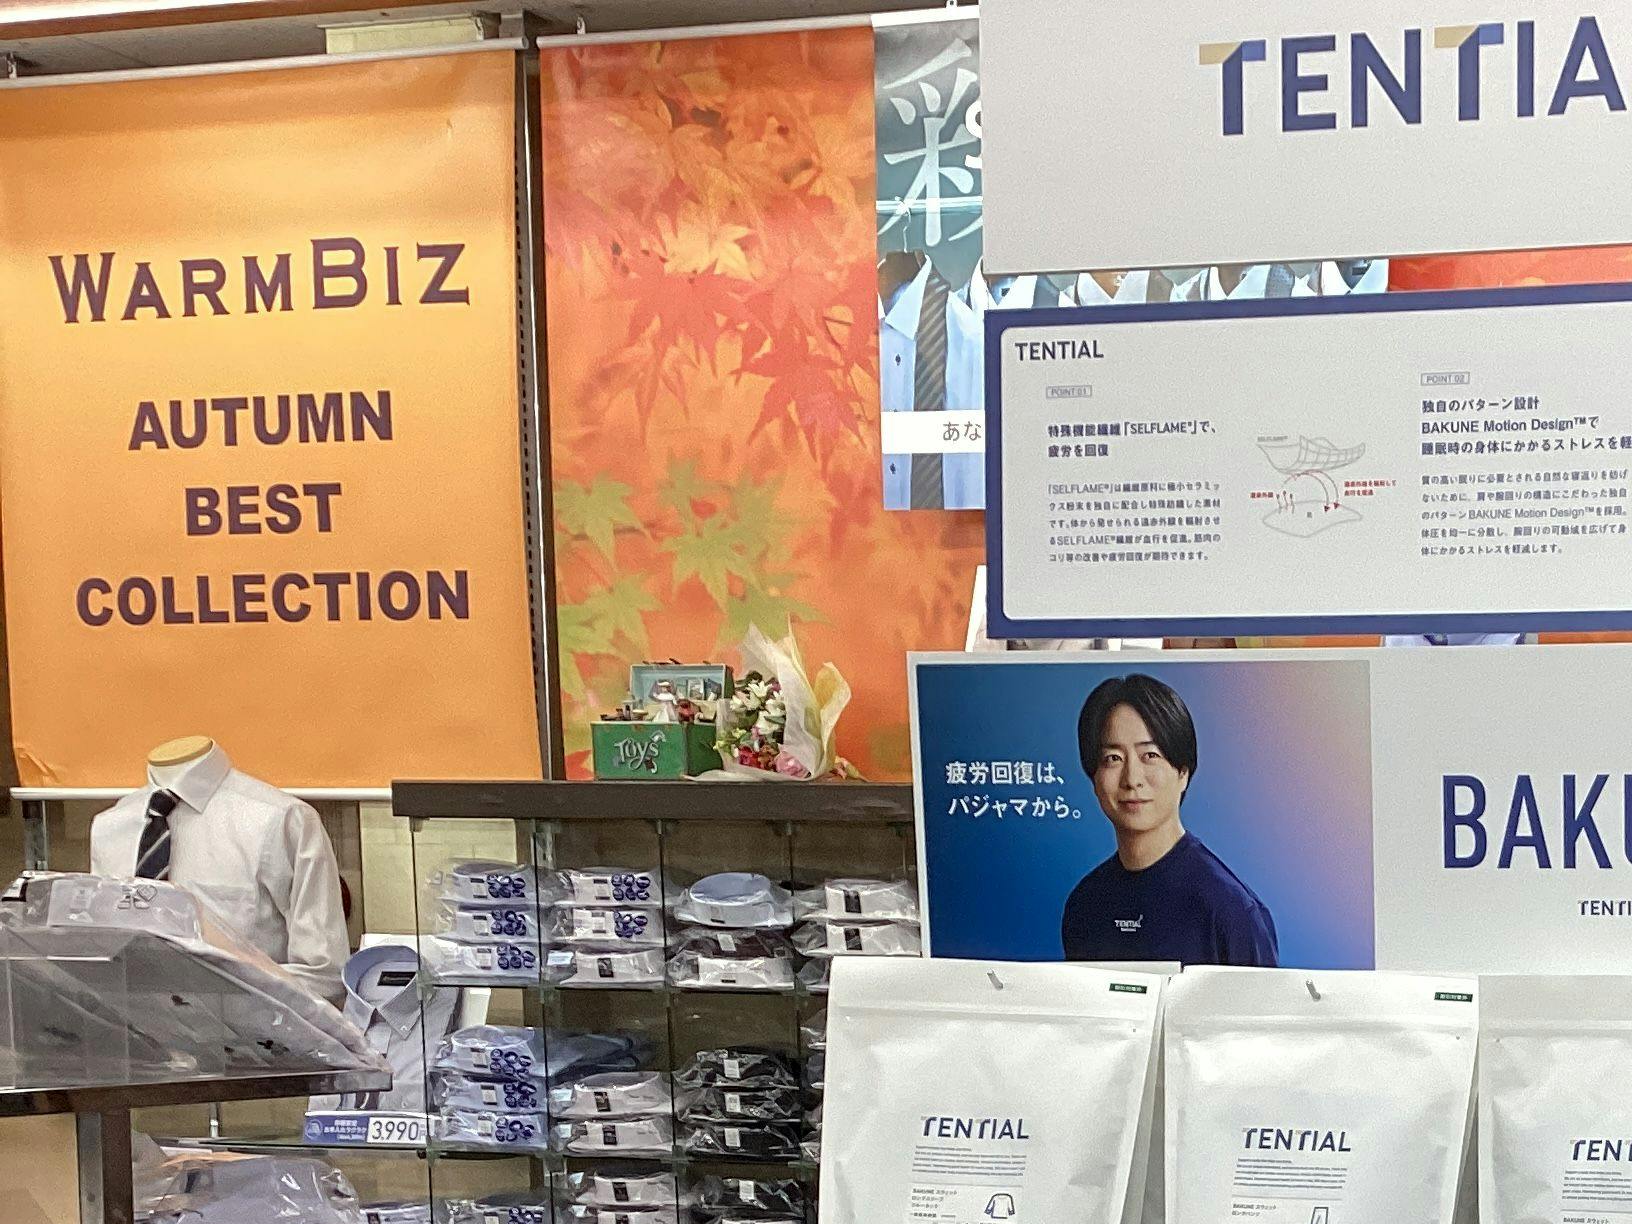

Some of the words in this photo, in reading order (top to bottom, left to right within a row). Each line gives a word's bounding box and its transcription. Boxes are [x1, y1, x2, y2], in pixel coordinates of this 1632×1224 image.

[1015, 340, 1104, 361] TENTIAL
[1426, 374, 1451, 384] POINT
[1454, 374, 1465, 383] 02
[1422, 396, 1540, 413] 独自のパターン設計
[128, 391, 393, 450] AUTUMN
[1421, 420, 1480, 434] BAKUNE
[1483, 419, 1527, 432] Motion
[185, 482, 342, 536] BEST
[1514, 508, 1548, 520] Motion
[75, 570, 470, 626] COLLECTION
[945, 758, 1067, 787] 疲労回復は、
[947, 796, 1083, 822] パジャマから。
[921, 1116, 1029, 1140] TENTIAL
[1242, 1127, 1352, 1153] TENTIAL
